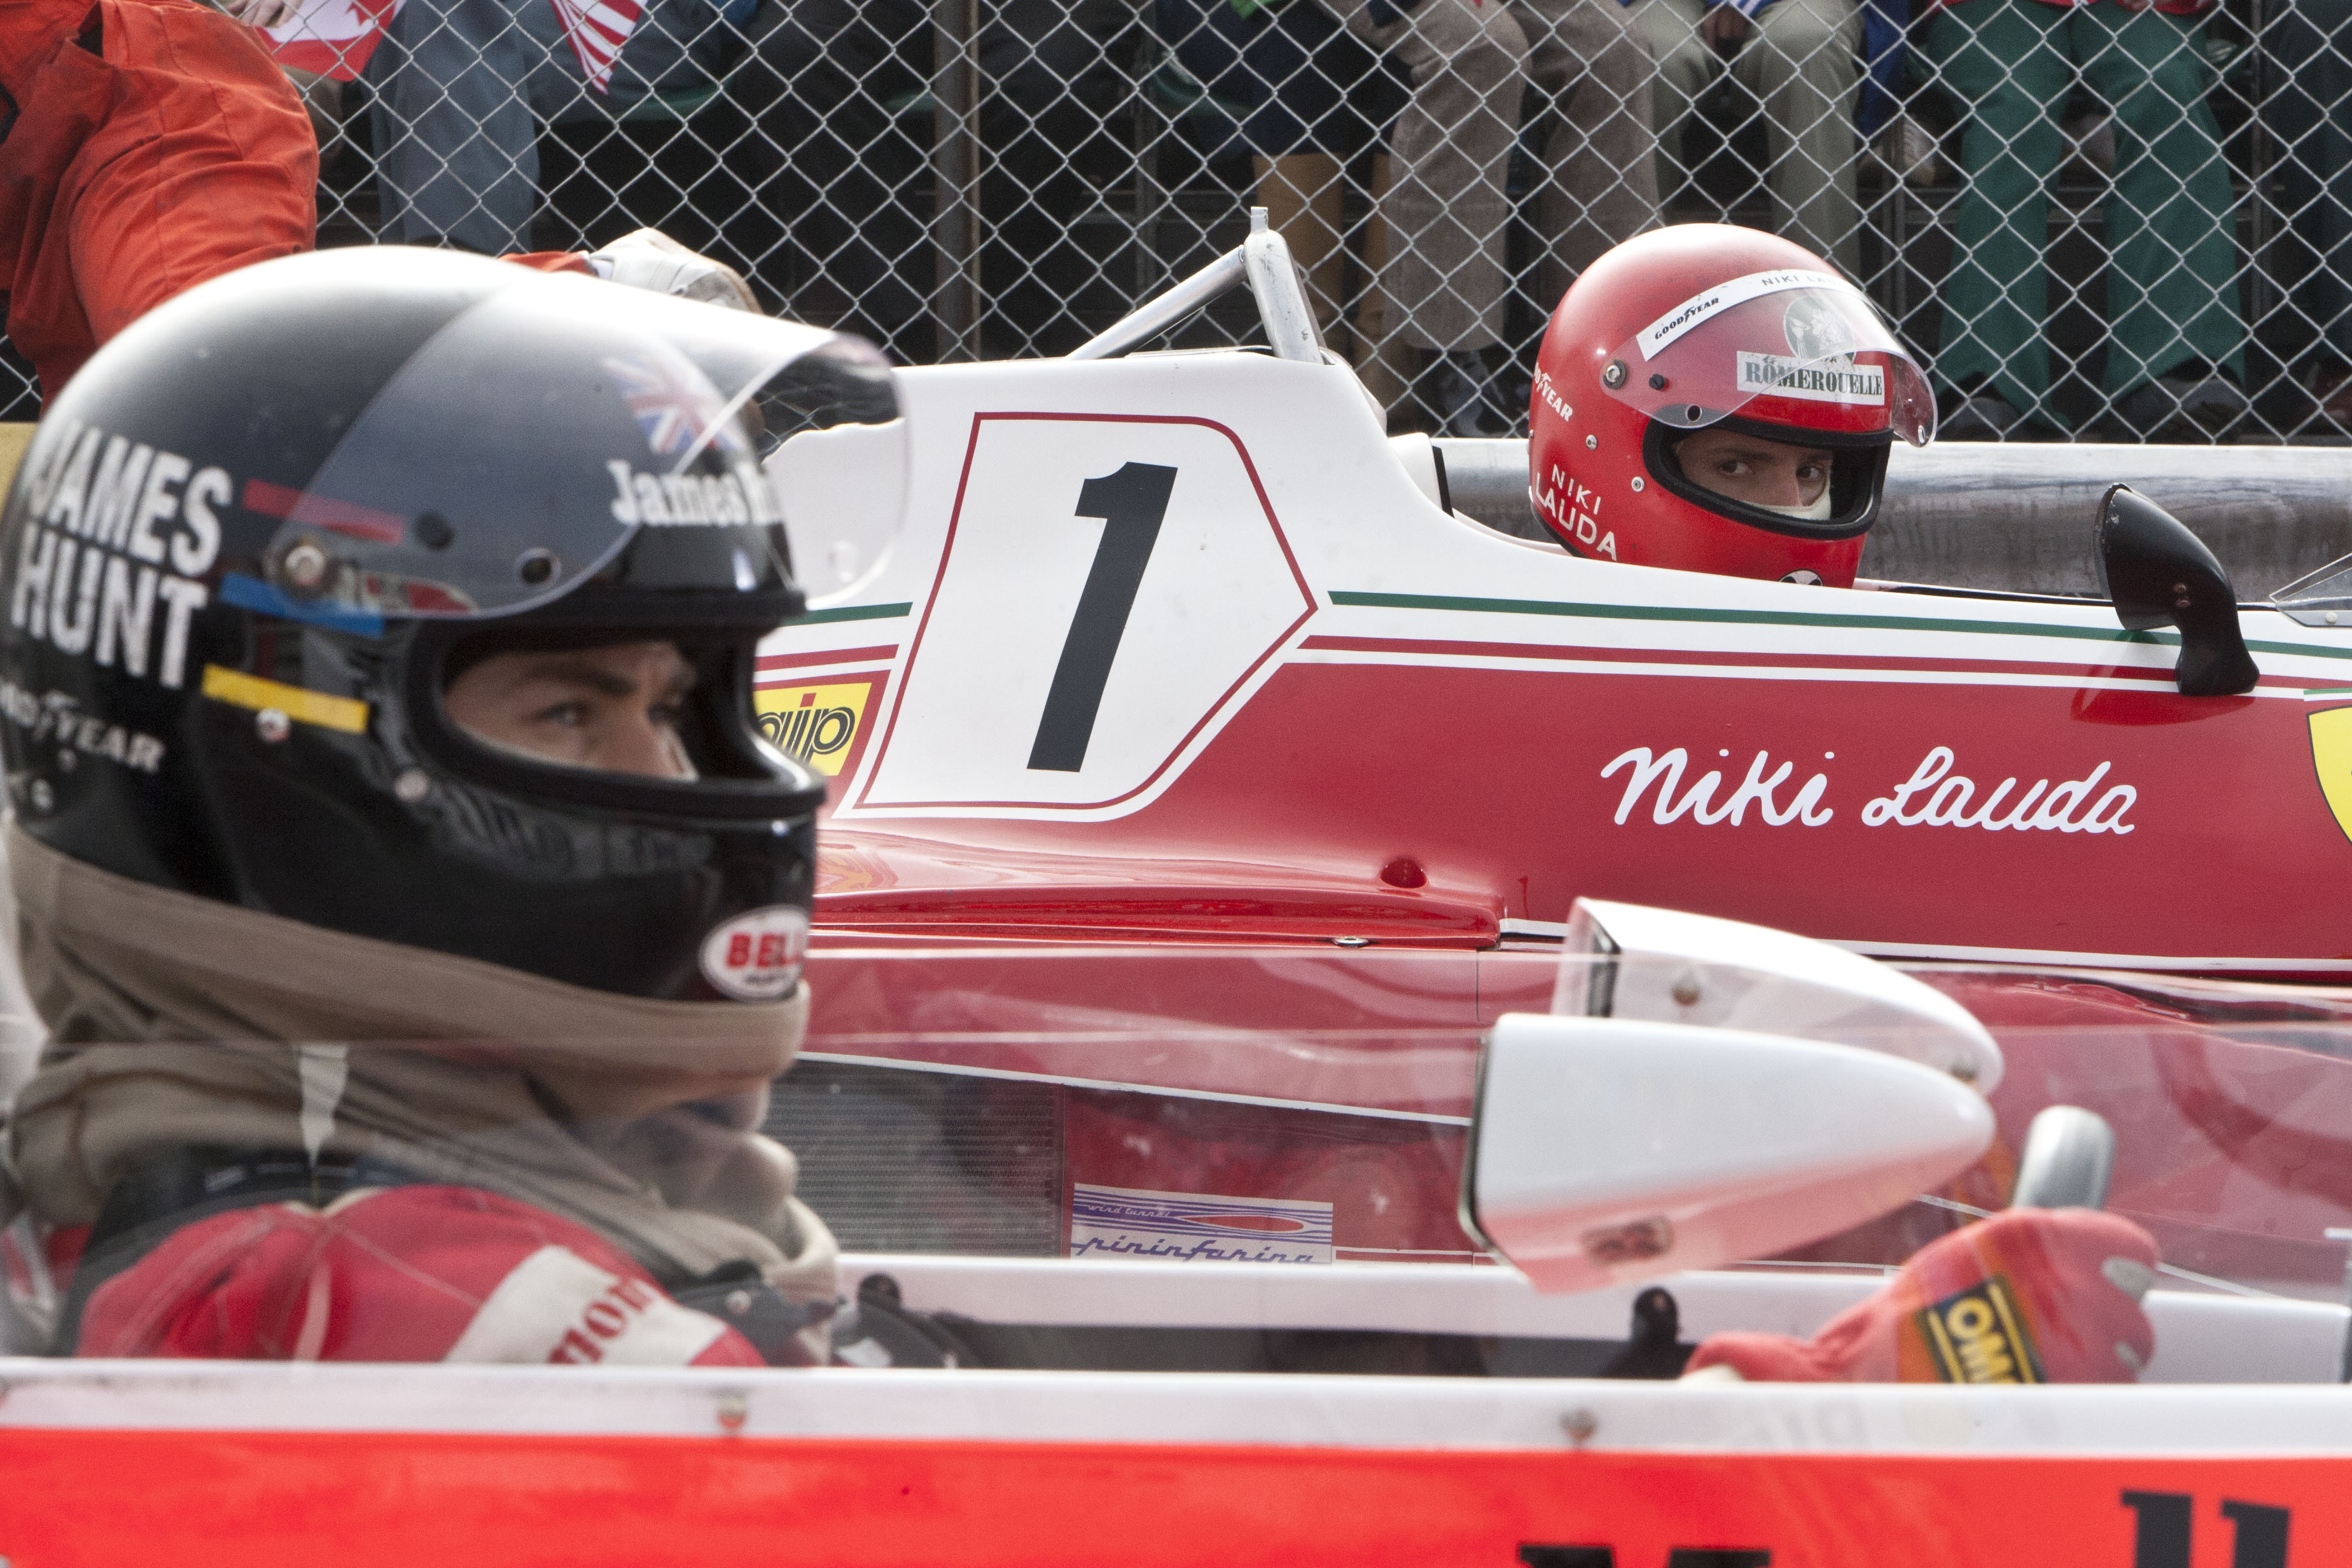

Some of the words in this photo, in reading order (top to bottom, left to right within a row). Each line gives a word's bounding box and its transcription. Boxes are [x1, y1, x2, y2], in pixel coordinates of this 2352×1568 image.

[1655, 297, 1719, 340] GOODYEAR
[1761, 275, 1799, 286] NIKI
[1536, 472, 1617, 561] LAUDA
[1552, 464, 1601, 515] NIKI
[11, 520, 209, 690] HUNT
[1027, 461, 1178, 773] 1
[1861, 746, 2138, 835] Lauda
